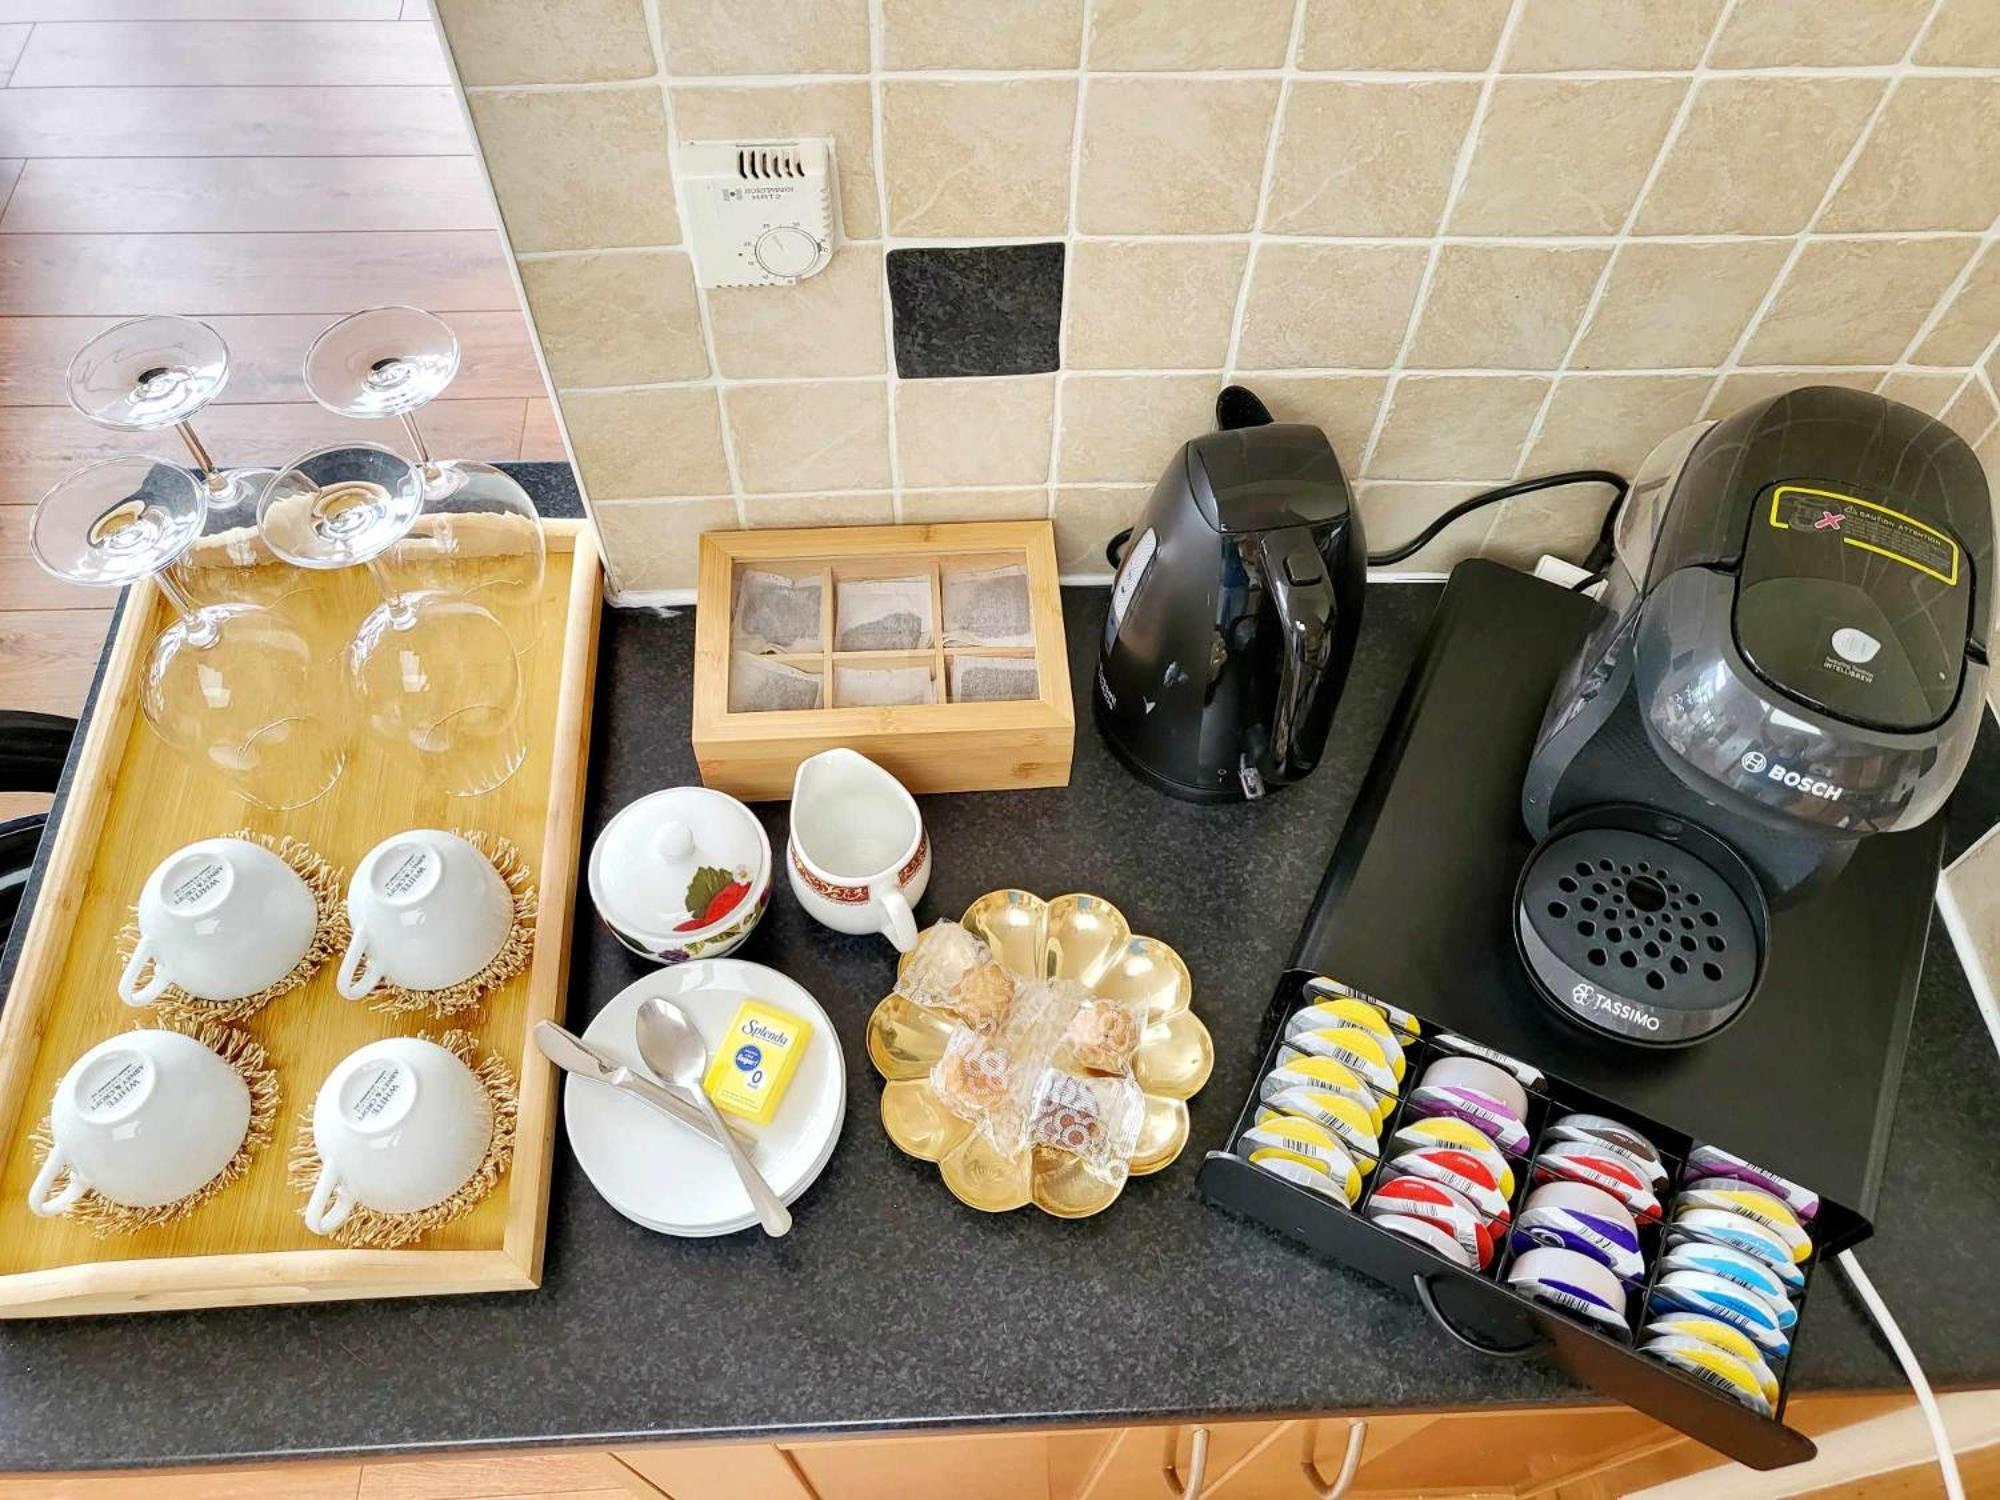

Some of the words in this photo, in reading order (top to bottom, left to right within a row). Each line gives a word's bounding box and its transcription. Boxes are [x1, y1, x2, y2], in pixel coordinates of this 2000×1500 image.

[1767, 763, 1844, 802] BOSCH
[187, 879, 221, 903] WHITE
[399, 867, 427, 895] WHITE
[1593, 992, 1660, 1031] TASSIMO
[741, 1018, 789, 1046] Splenda
[751, 1069, 763, 1084] 0
[106, 1079, 141, 1108] WHITE
[371, 1085, 401, 1117] WHITE
